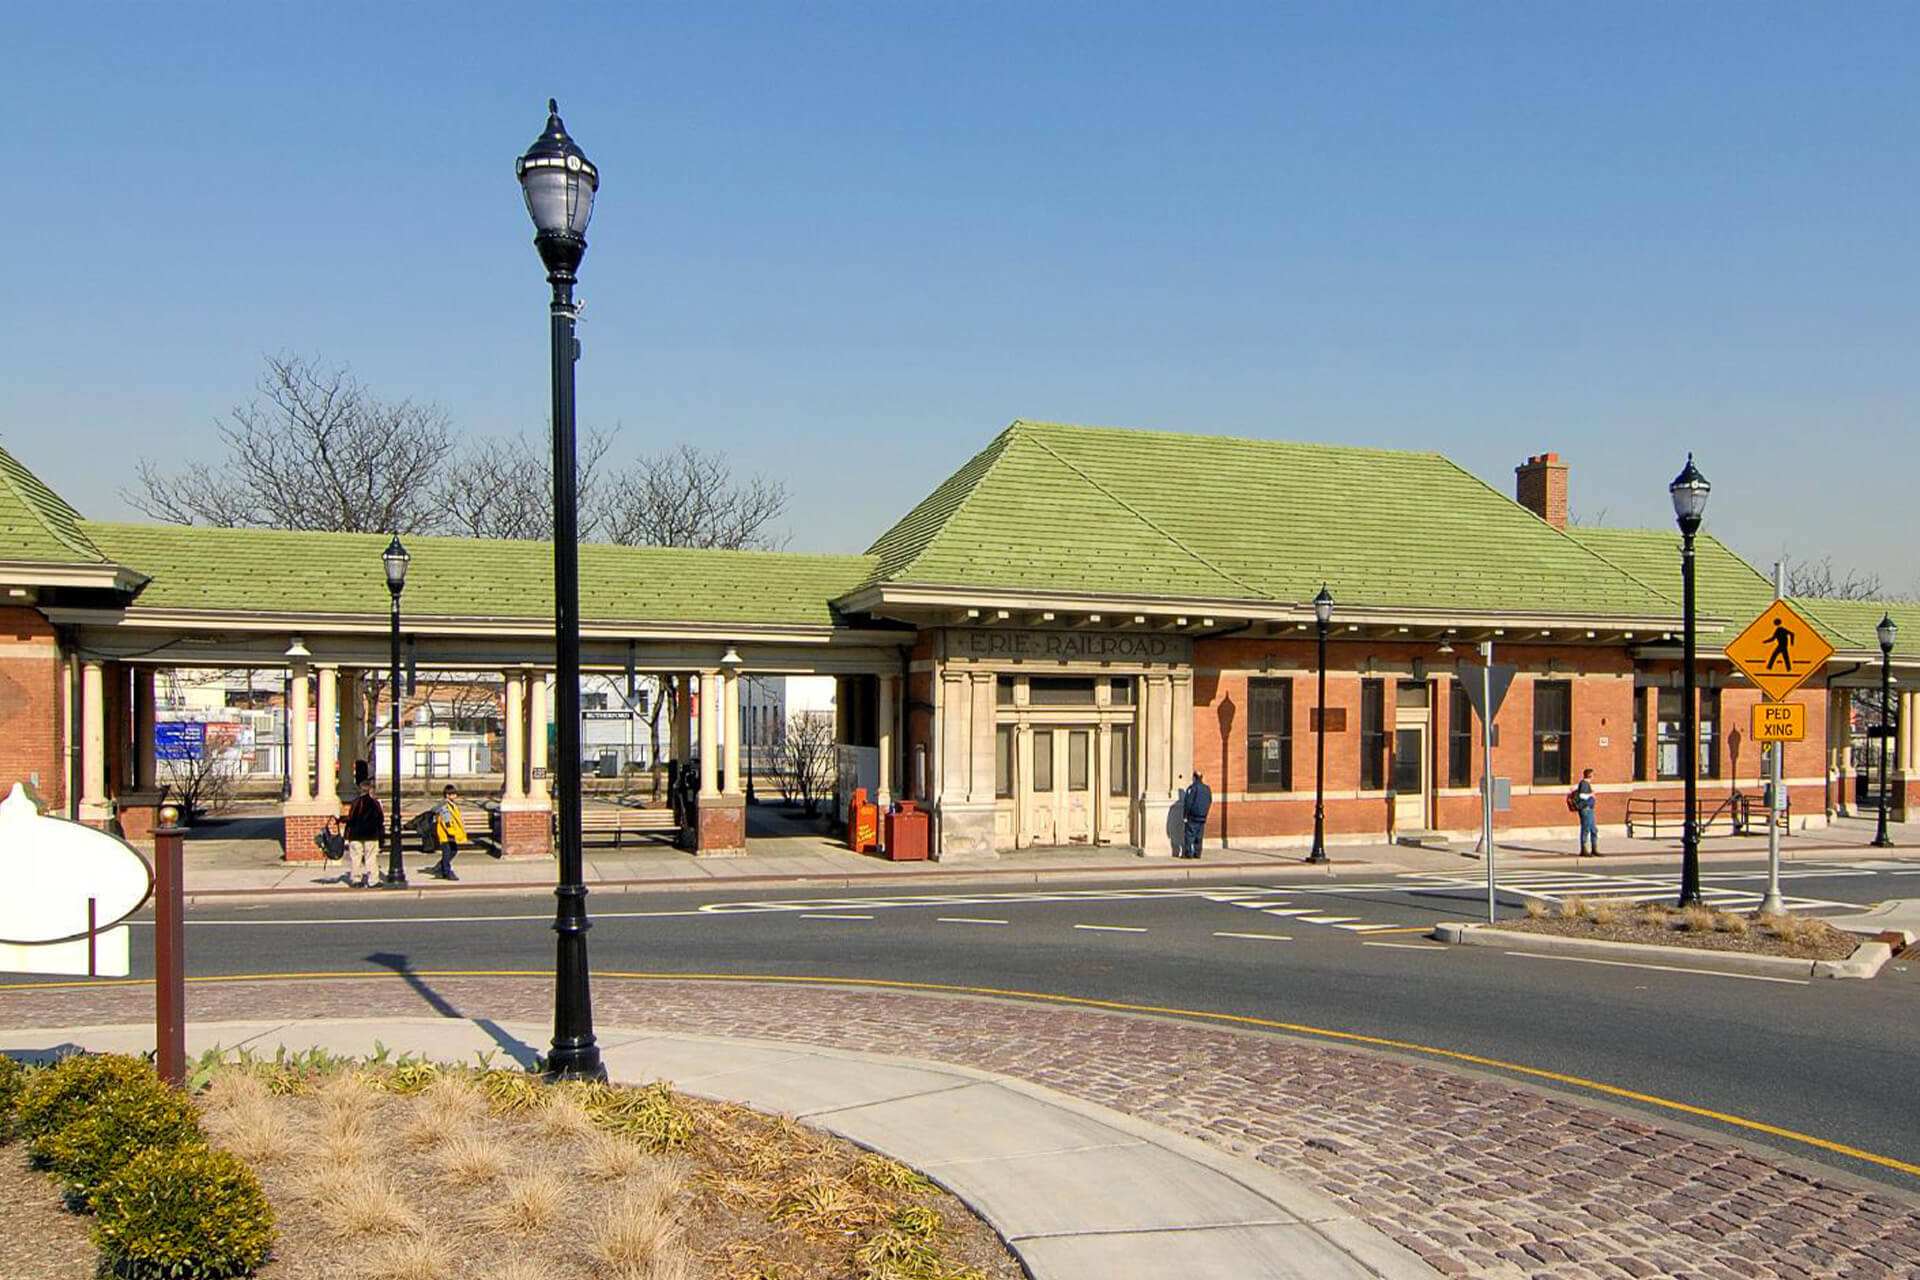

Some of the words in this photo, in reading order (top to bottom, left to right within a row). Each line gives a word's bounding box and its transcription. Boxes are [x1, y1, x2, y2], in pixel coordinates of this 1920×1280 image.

[970, 633, 1030, 654] ERIE
[1045, 635, 1167, 657] RAILROAD
[1766, 708, 1791, 720] PED
[1764, 724, 1793, 736] XING
